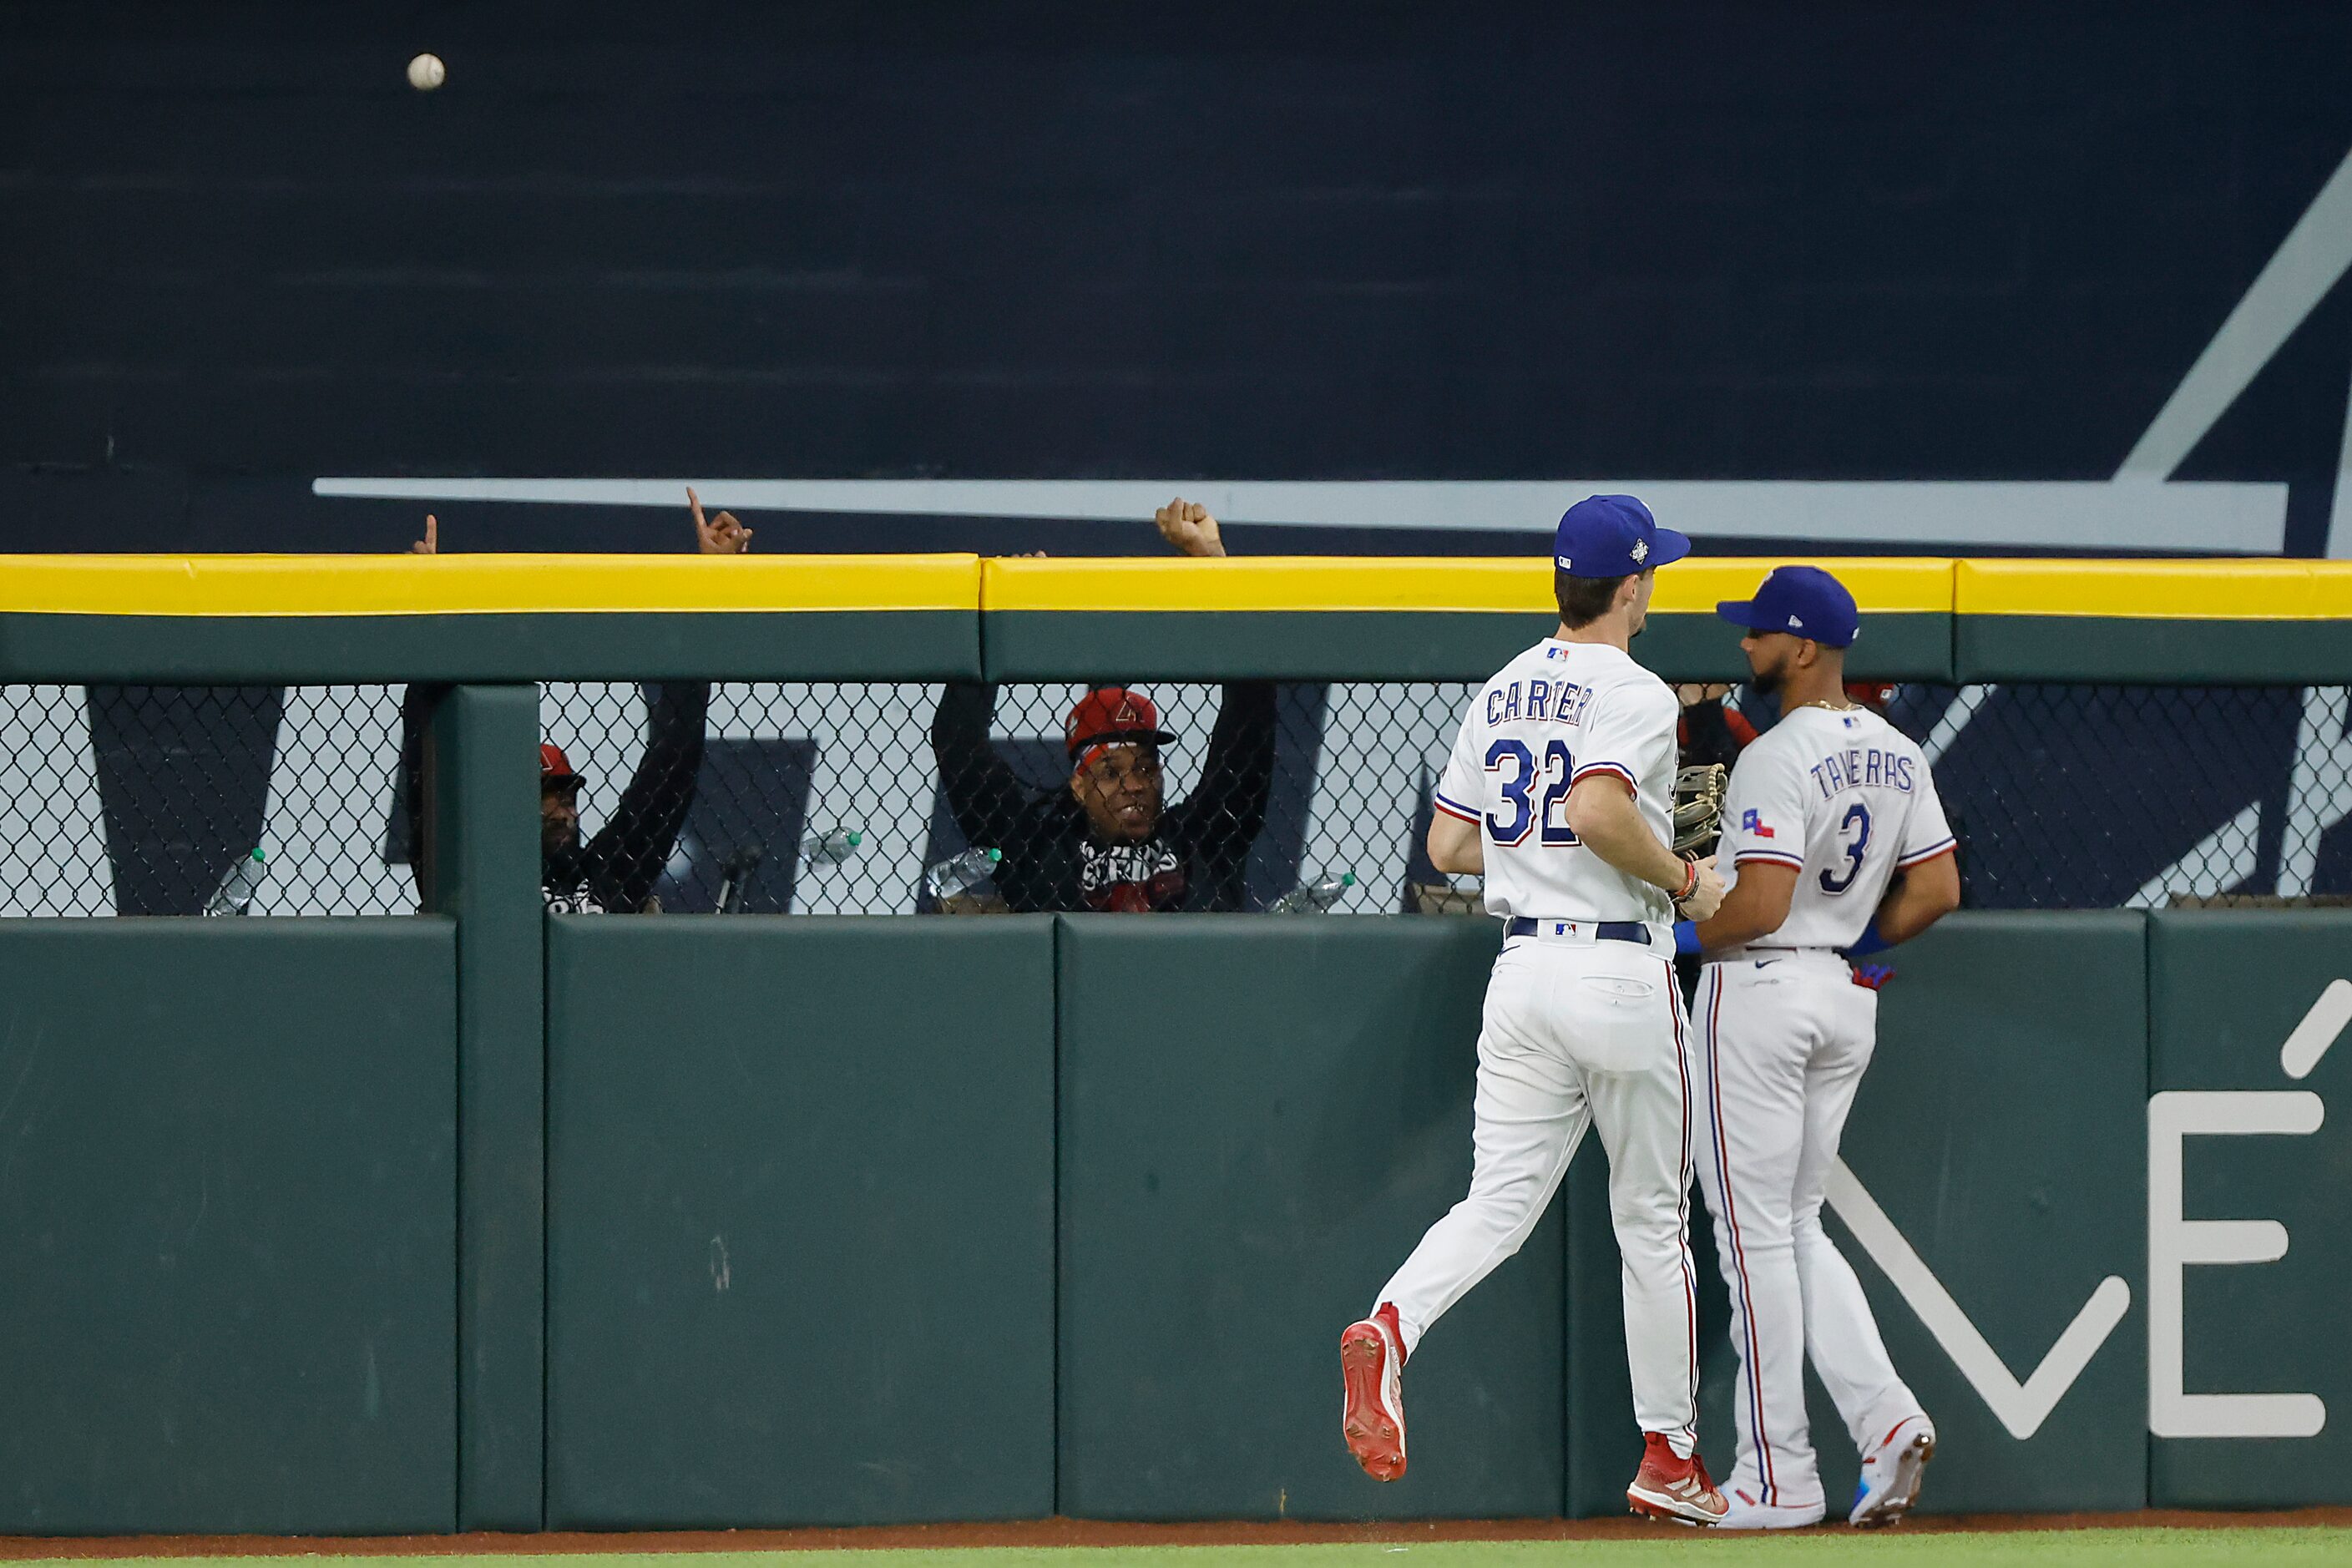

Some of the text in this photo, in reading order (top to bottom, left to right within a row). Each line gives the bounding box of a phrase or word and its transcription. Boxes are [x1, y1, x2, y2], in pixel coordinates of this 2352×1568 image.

[1485, 738, 1582, 847] 32
[1810, 748, 1914, 802] TAVERAS
[1818, 802, 1874, 896] 3
